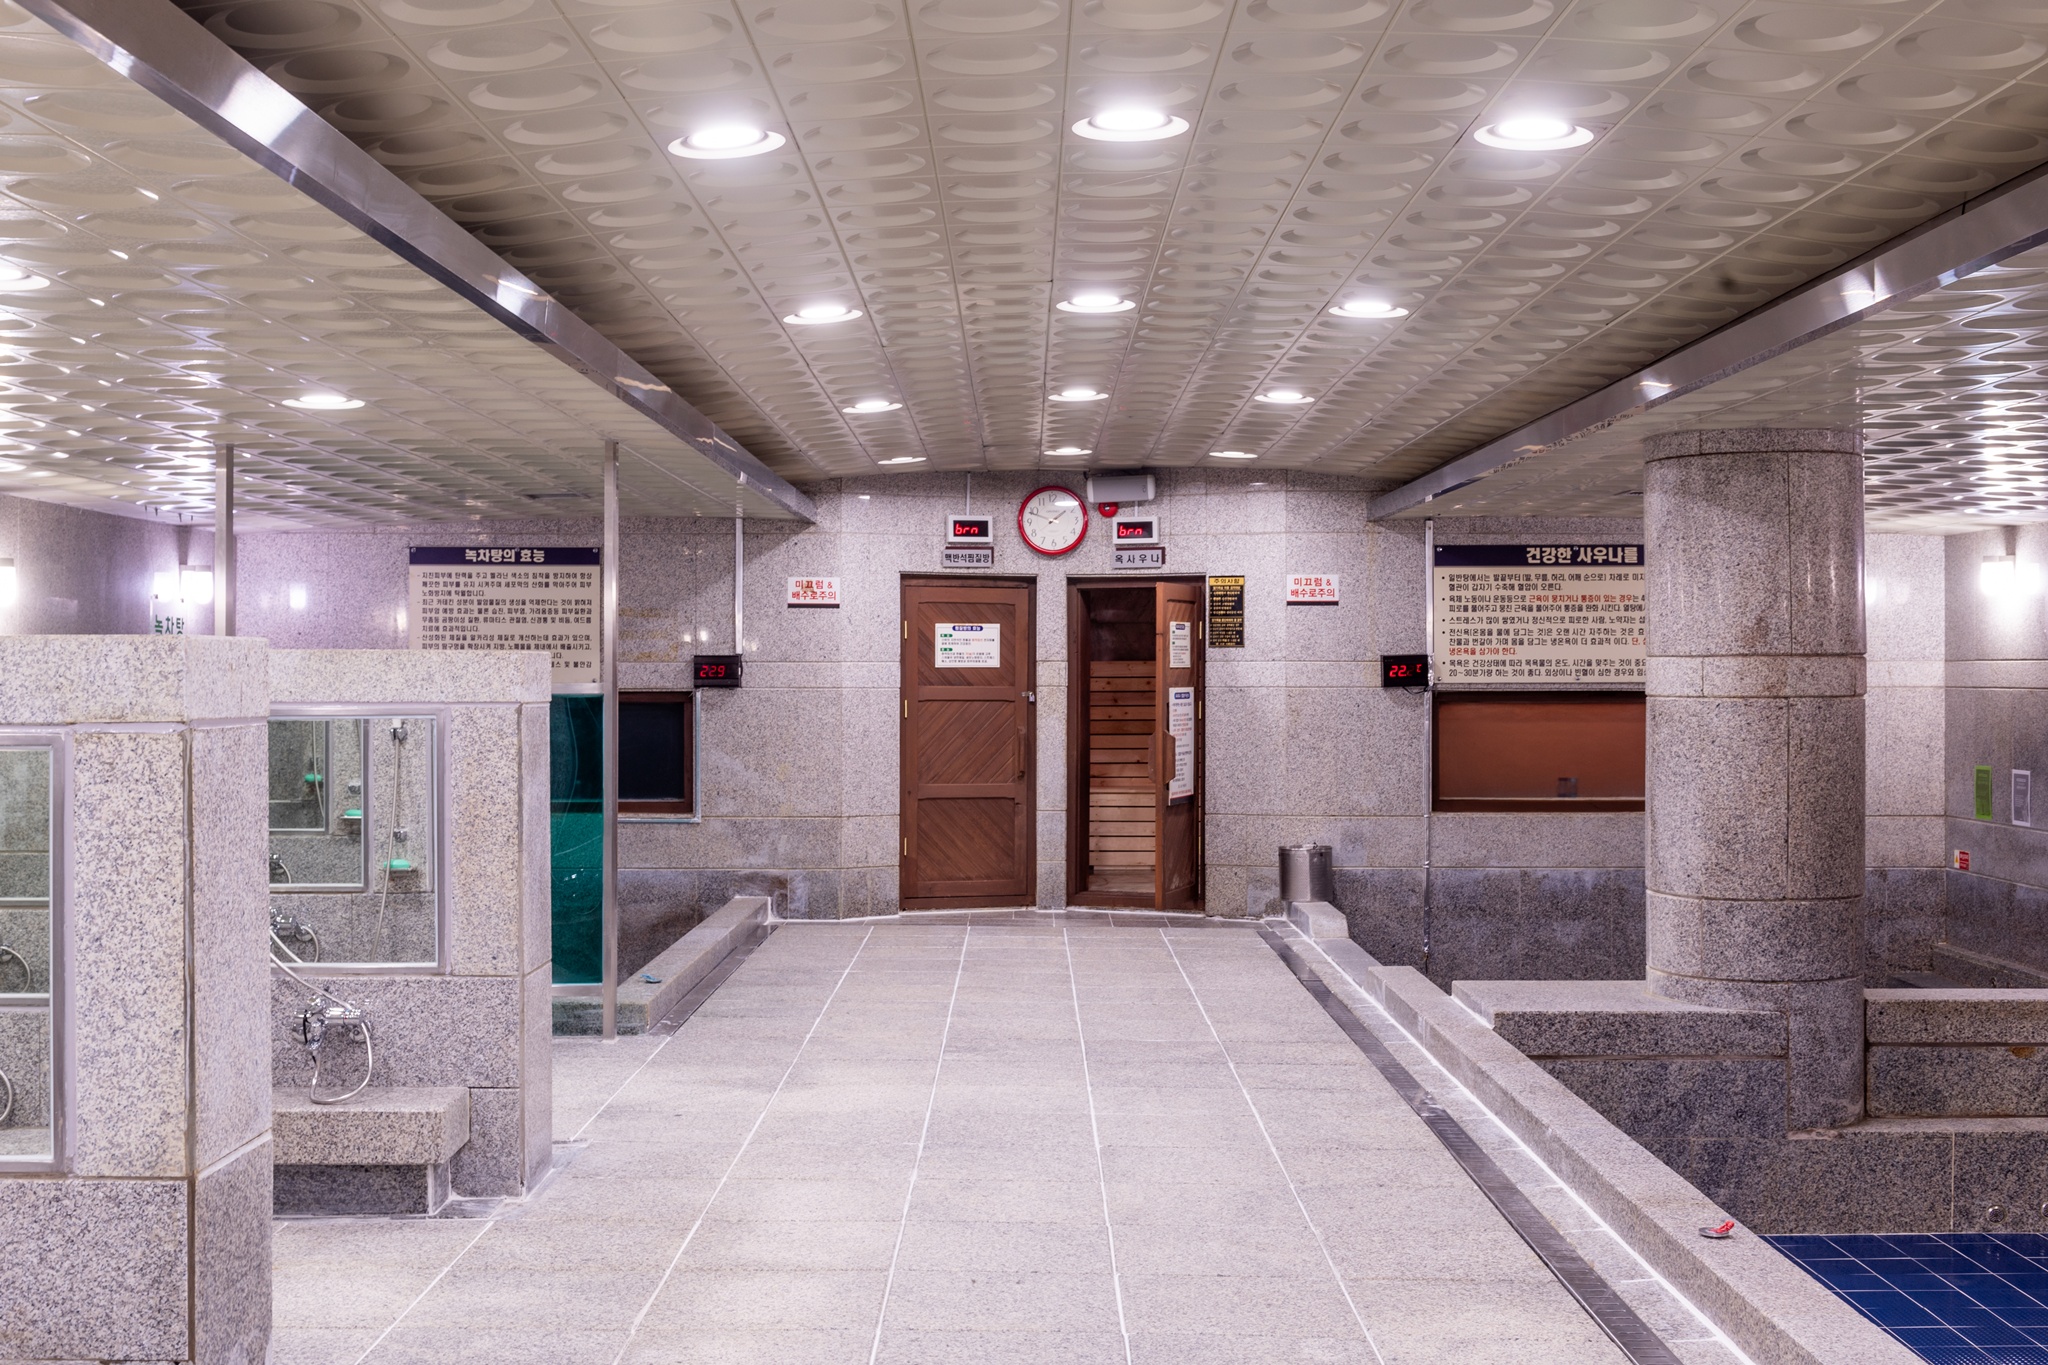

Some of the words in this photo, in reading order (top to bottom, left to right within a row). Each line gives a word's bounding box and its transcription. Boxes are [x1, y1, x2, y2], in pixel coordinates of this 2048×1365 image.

[1048, 494, 1057, 502] 12
[465, 549, 515, 562] 녹차탕의
[520, 549, 545, 562] 효능
[945, 554, 990, 563] 맥반석찜질방
[1526, 547, 1572, 564] 건강한
[1577, 547, 1638, 563] 사우나를
[422, 572, 452, 580] 지친피부에
[455, 572, 473, 580] 탄력을
[476, 572, 487, 580] 주고
[511, 572, 529, 580] 색소의
[1448, 573, 1490, 583] 일반탕에서는
[1493, 573, 1521, 582] 발끝부터
[1568, 573, 1582, 582] 어깨
[1609, 573, 1629, 582] 차례로
[795, 580, 823, 589] 미끄럼
[1294, 578, 1322, 586] 미끄럼
[1448, 583, 1469, 592] 혈관이
[1471, 583, 1492, 592] 갑자기
[1494, 583, 1515, 592] 수축해
[1517, 582, 1538, 592] 혈압이
[792, 591, 836, 600] 배수로주의
[1290, 588, 1335, 598] 배수로주의
[509, 598, 526, 606] 생성을
[1449, 594, 1463, 603] 육체
[1464, 594, 1492, 604] 노동이나
[1493, 594, 1527, 604] 운동등으로
[1529, 594, 1549, 603] 근육이
[1581, 594, 1601, 604] 통증이
[1603, 594, 1616, 603] 있는
[1619, 594, 1639, 603] 경우는
[1449, 604, 1469, 613] 피로를
[1471, 604, 1497, 613] 풀어주고
[1499, 604, 1513, 613] 뭉친
[1514, 604, 1534, 613] 근육을
[1535, 604, 1562, 613] 풀어주어
[1564, 603, 1583, 613] 통증을
[1585, 604, 1599, 613] 완화
[154, 614, 184, 634] 녹차탕
[1449, 616, 1484, 625] 스트레스가
[1485, 616, 1500, 625] 많이
[1531, 615, 1566, 625] 정신적으로
[1568, 616, 1589, 624] 피로한
[1609, 615, 1636, 624] 노약자는
[1496, 628, 1510, 637] 물에
[1513, 628, 1534, 637] 담그는
[1571, 628, 1586, 636] 시간
[1588, 627, 1616, 636] 자주하는
[1620, 627, 1634, 636] 것은
[1449, 637, 1470, 647] 찬물과
[1472, 637, 1493, 646] 번갈아
[1495, 637, 1509, 646] 가며
[1511, 637, 1525, 646] 몸을
[1527, 637, 1547, 646] 담그는
[1550, 637, 1578, 646] 냉온욕이
[1580, 637, 1588, 646] 더
[1590, 637, 1611, 646] 효과적
[1449, 647, 1476, 656] 냉온욕을
[1449, 659, 1470, 668] 목욕은
[1472, 659, 1507, 668] 건강상태에
[1508, 659, 1523, 668] 따라
[1525, 658, 1553, 668] 목욕물의
[1572, 658, 1593, 668] 시간을
[1618, 658, 1632, 667] 것이
[1495, 668, 1509, 677] 하는
[1511, 668, 1525, 677] 것이
[1544, 668, 1573, 678] 외상이나
[1574, 668, 1595, 678] 빈혈이
[1597, 668, 1612, 677] 심한
[1614, 668, 1635, 677] 경우와
